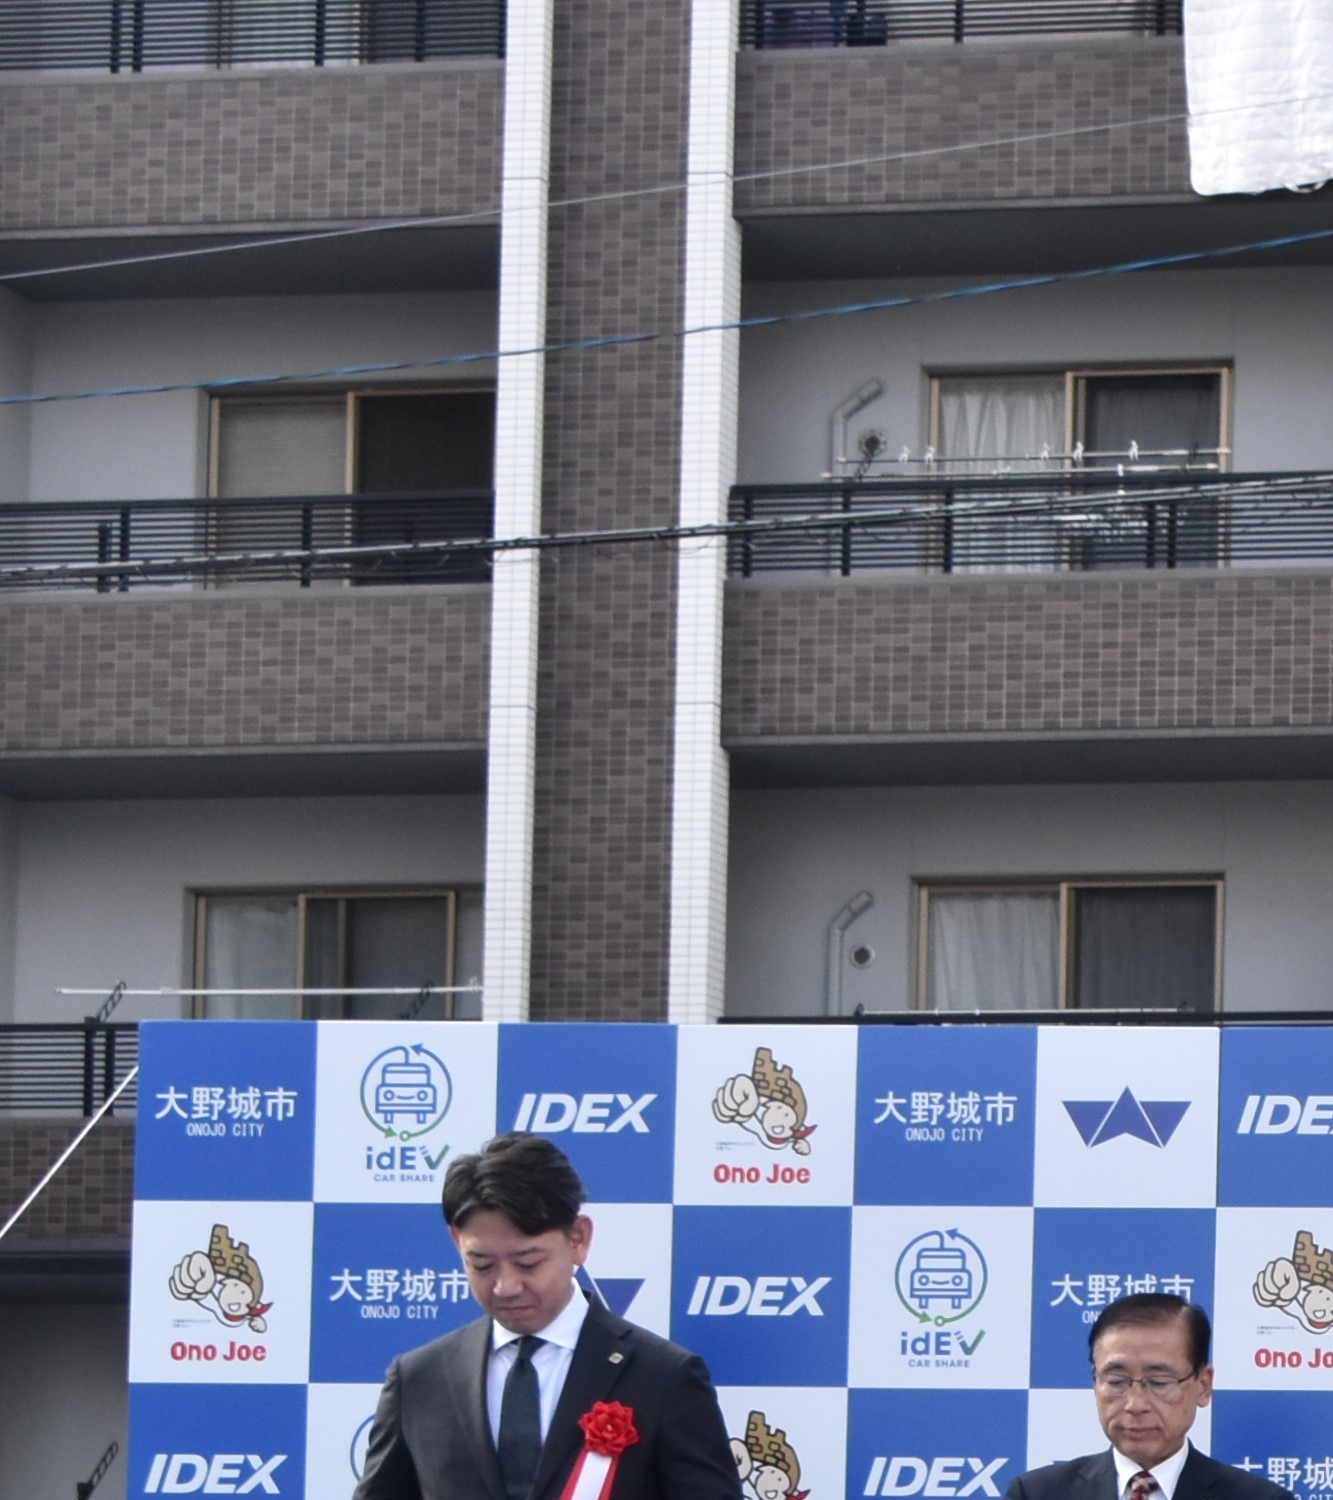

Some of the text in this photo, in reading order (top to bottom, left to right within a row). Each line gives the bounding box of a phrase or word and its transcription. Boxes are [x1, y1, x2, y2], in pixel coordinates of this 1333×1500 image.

[156, 1087, 297, 1120] 大野城市
[514, 1094, 657, 1132] IDEX
[875, 1091, 1017, 1125] 大野城市
[187, 1123, 264, 1136] ONOJO CITY
[906, 1128, 983, 1141] ONOJO CITY
[400, 1174, 433, 1182] SHARE
[714, 1164, 810, 1183] Ono Joe
[330, 1267, 473, 1302] 大野城市
[688, 1276, 831, 1315] IDEX
[361, 1305, 438, 1318] ONOJO CITY
[171, 1342, 266, 1360] Ono Joe
[1254, 1348, 1303, 1368] Ono
[145, 1454, 287, 1493] IDEX
[864, 1457, 1008, 1497] IDEX
